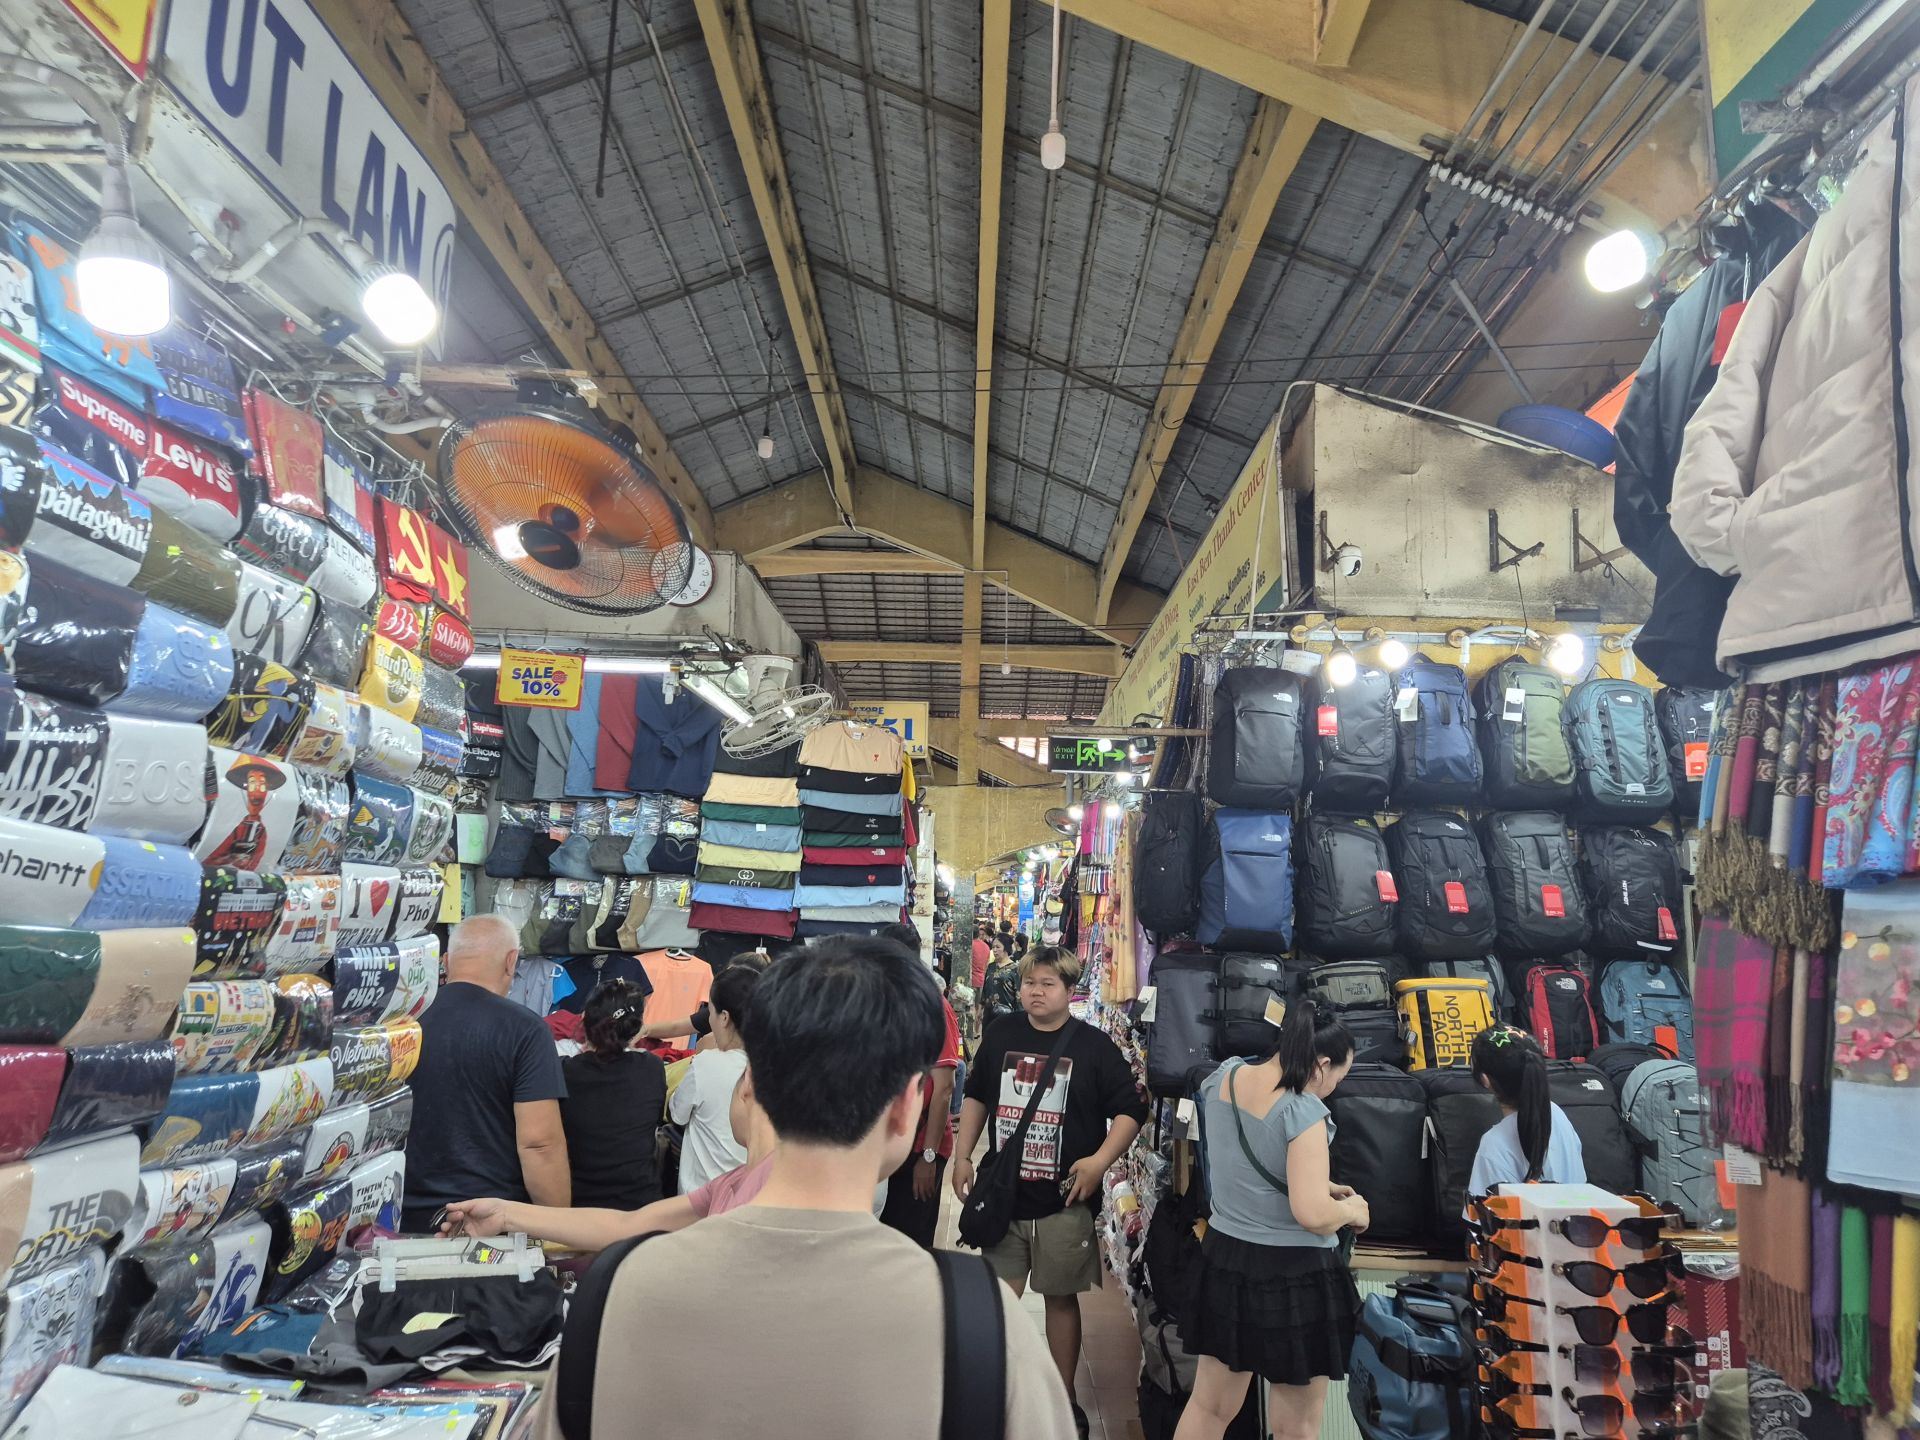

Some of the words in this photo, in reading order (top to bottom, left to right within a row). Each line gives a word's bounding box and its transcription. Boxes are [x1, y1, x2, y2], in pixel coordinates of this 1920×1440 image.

[321, 80, 426, 276] LAN
[60, 376, 147, 446] Supreme
[1200, 550, 1212, 580] Ben
[1213, 506, 1236, 557] Thanh
[1237, 458, 1265, 516] Center
[698, 557, 706, 565] 2
[702, 569, 709, 577] 3
[699, 580, 706, 588] 4
[680, 592, 688, 600] 6
[691, 589, 700, 597] 5
[512, 667, 553, 679] SALE
[522, 681, 560, 696] 10%
[472, 722, 504, 735] Supreme
[866, 718, 914, 740] 51
[728, 880, 761, 888] GUCCI
[350, 947, 390, 970] WHAT
[361, 971, 381, 988] THE
[1444, 995, 1466, 1055] NORTH
[1432, 1011, 1451, 1054] FACE
[1464, 1021, 1478, 1054] THE
[1000, 1106, 1017, 1118] BAD
[1033, 1171, 1055, 1180] KILLS
[356, 1181, 382, 1195] TINTIN
[48, 1192, 101, 1232] THE
